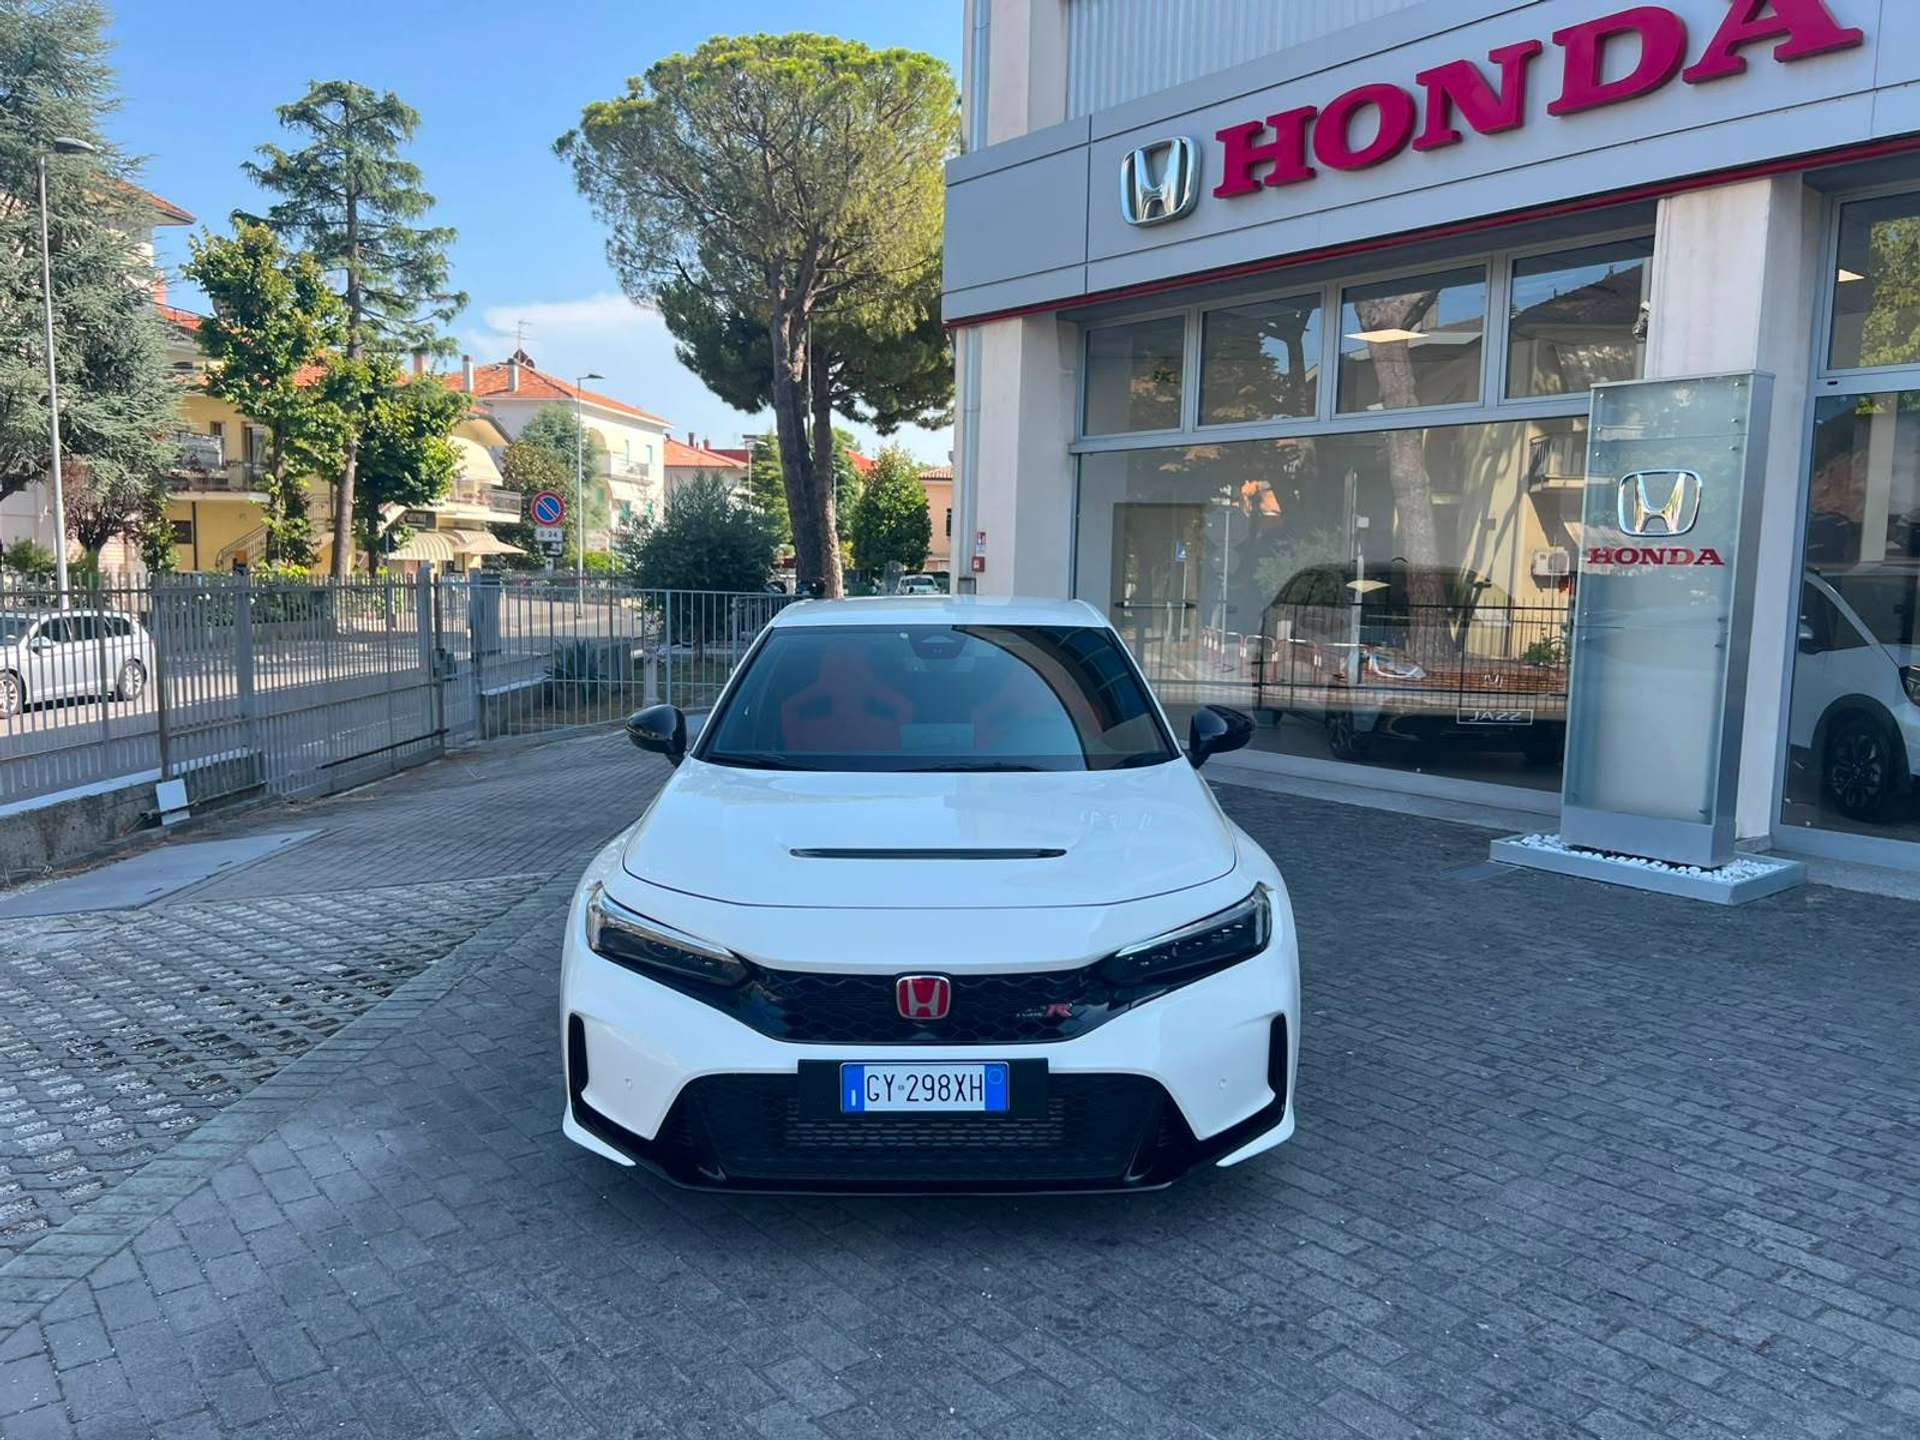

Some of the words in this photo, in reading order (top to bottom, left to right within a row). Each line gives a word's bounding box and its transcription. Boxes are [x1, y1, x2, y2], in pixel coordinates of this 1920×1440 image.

[1213, 0, 1864, 199] HONDA
[1587, 547, 1725, 566] HONDA
[1469, 710, 1522, 721] JAZZ
